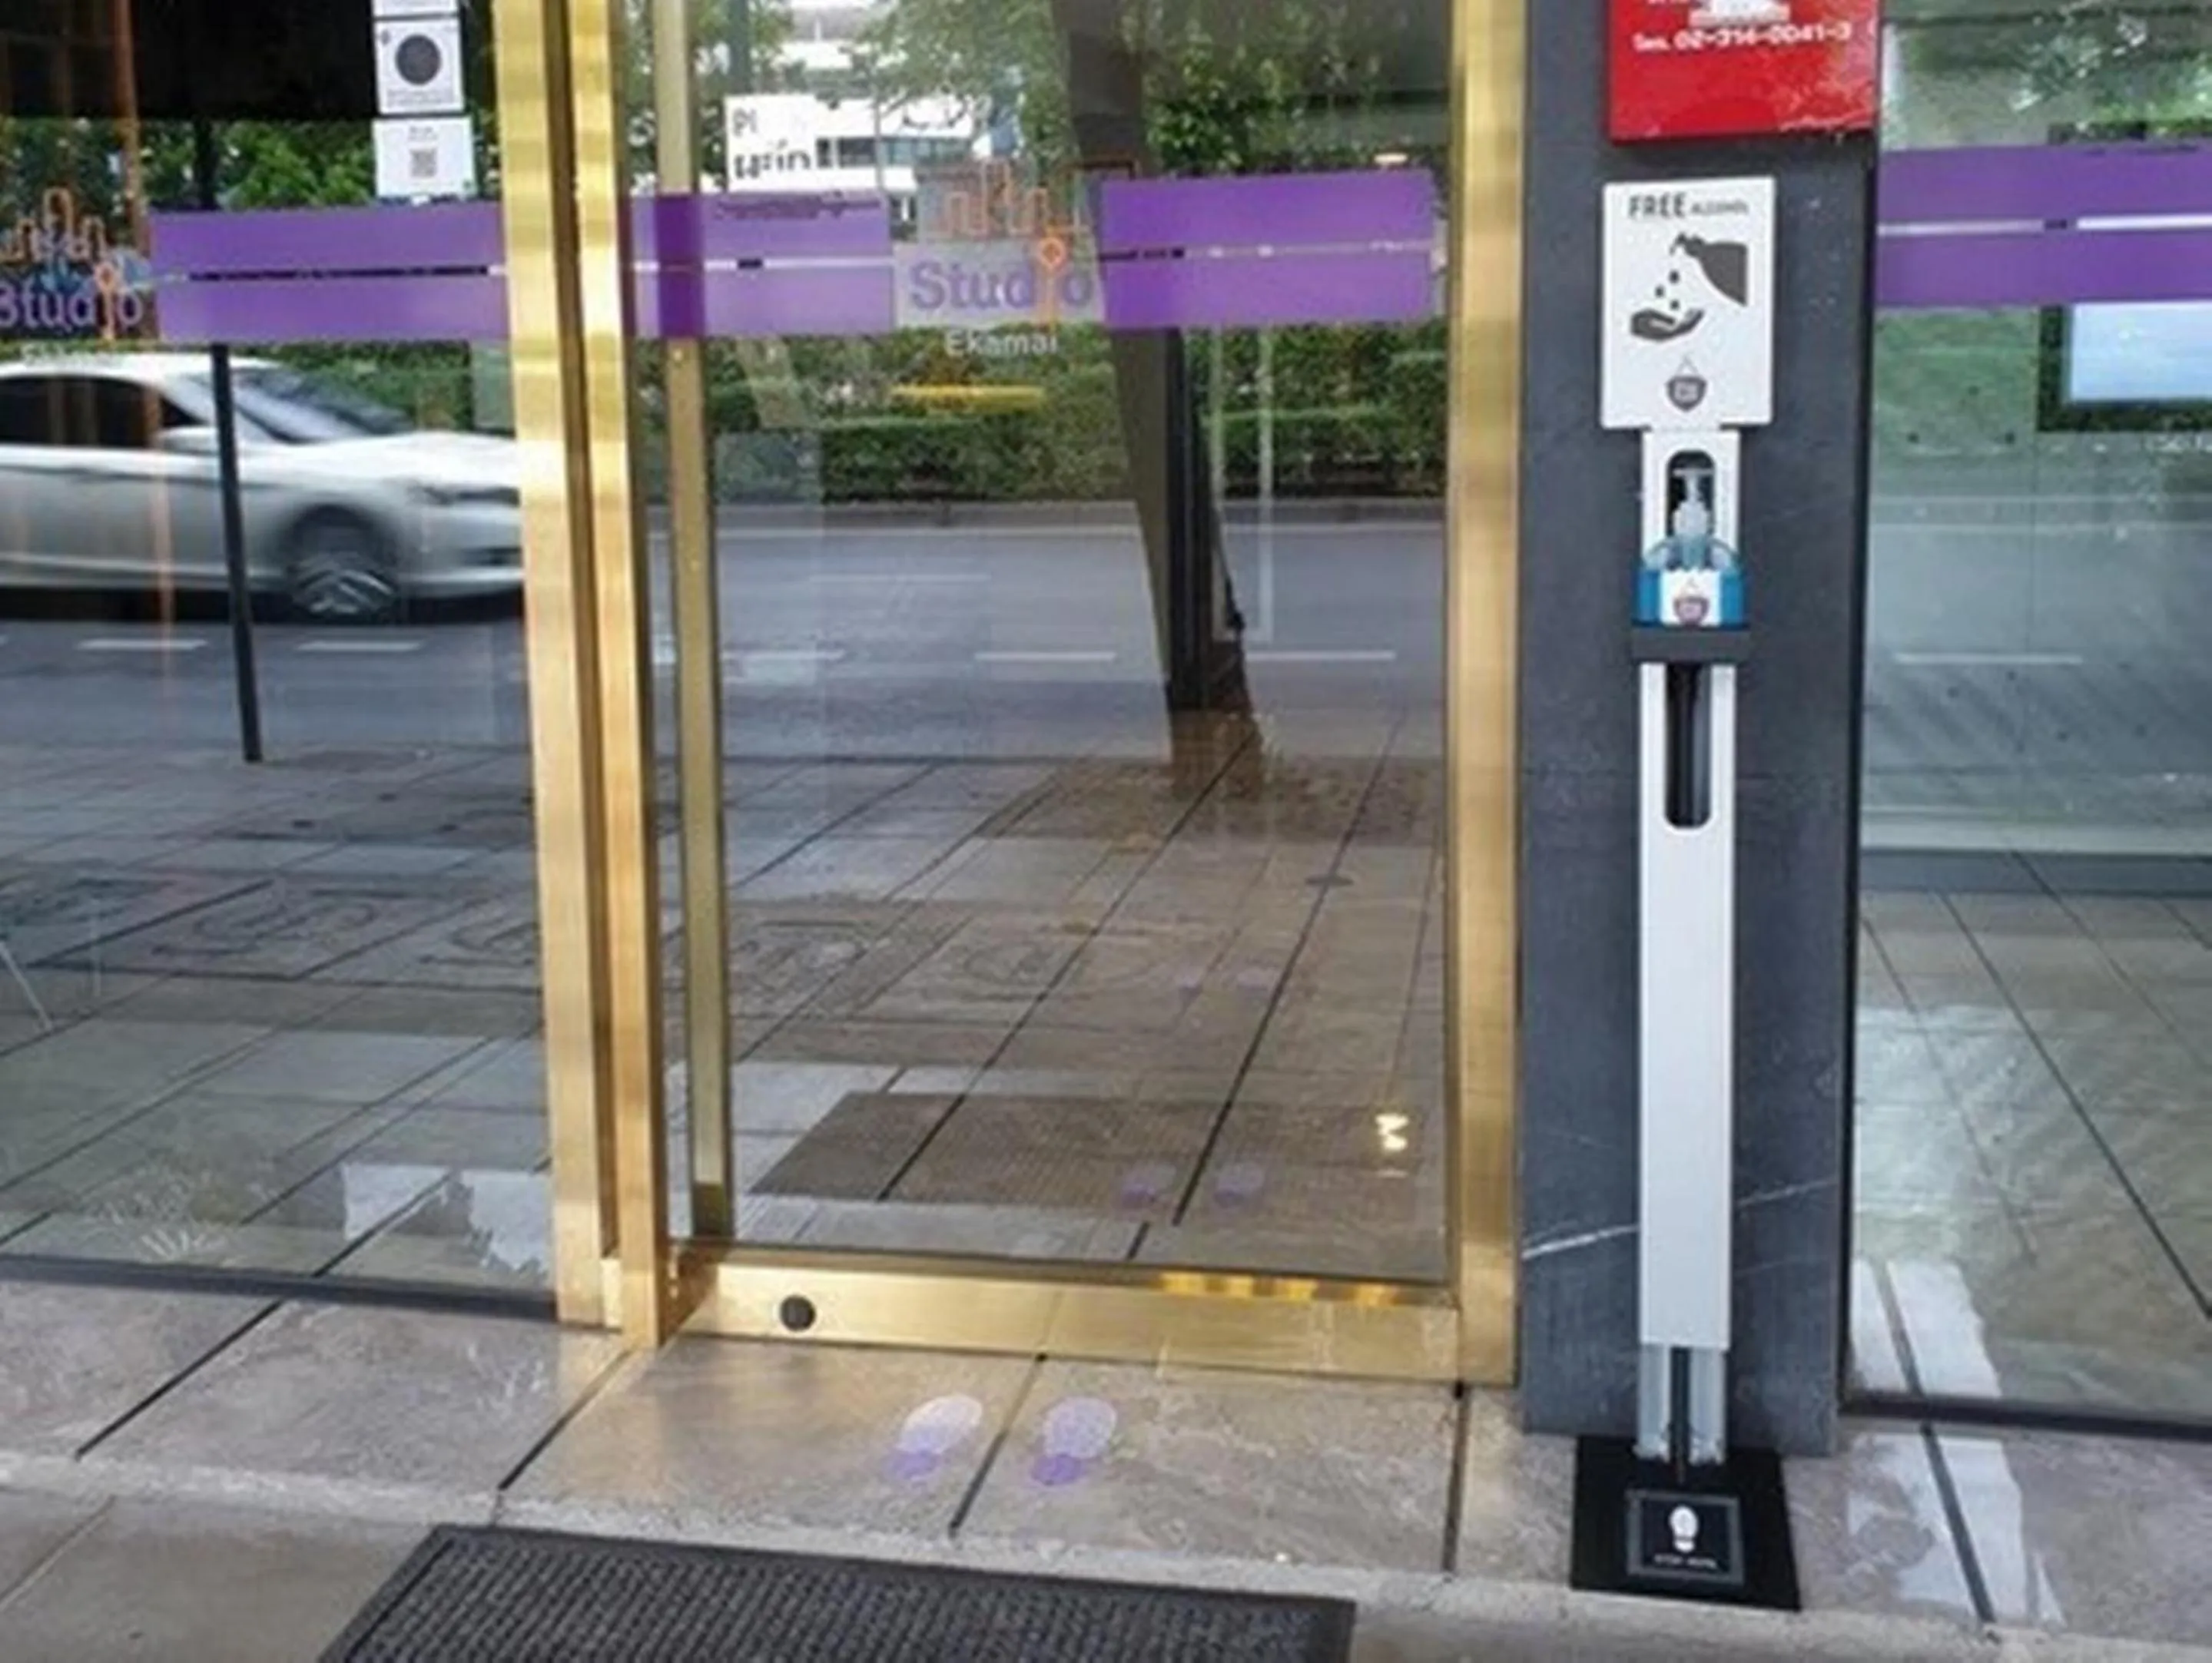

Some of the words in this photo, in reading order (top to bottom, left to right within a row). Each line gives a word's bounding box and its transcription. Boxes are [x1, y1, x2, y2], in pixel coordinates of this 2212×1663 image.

[1628, 191, 1687, 220] FREE
[908, 250, 1095, 318] Studio
[944, 329, 1059, 358] Ekamai
